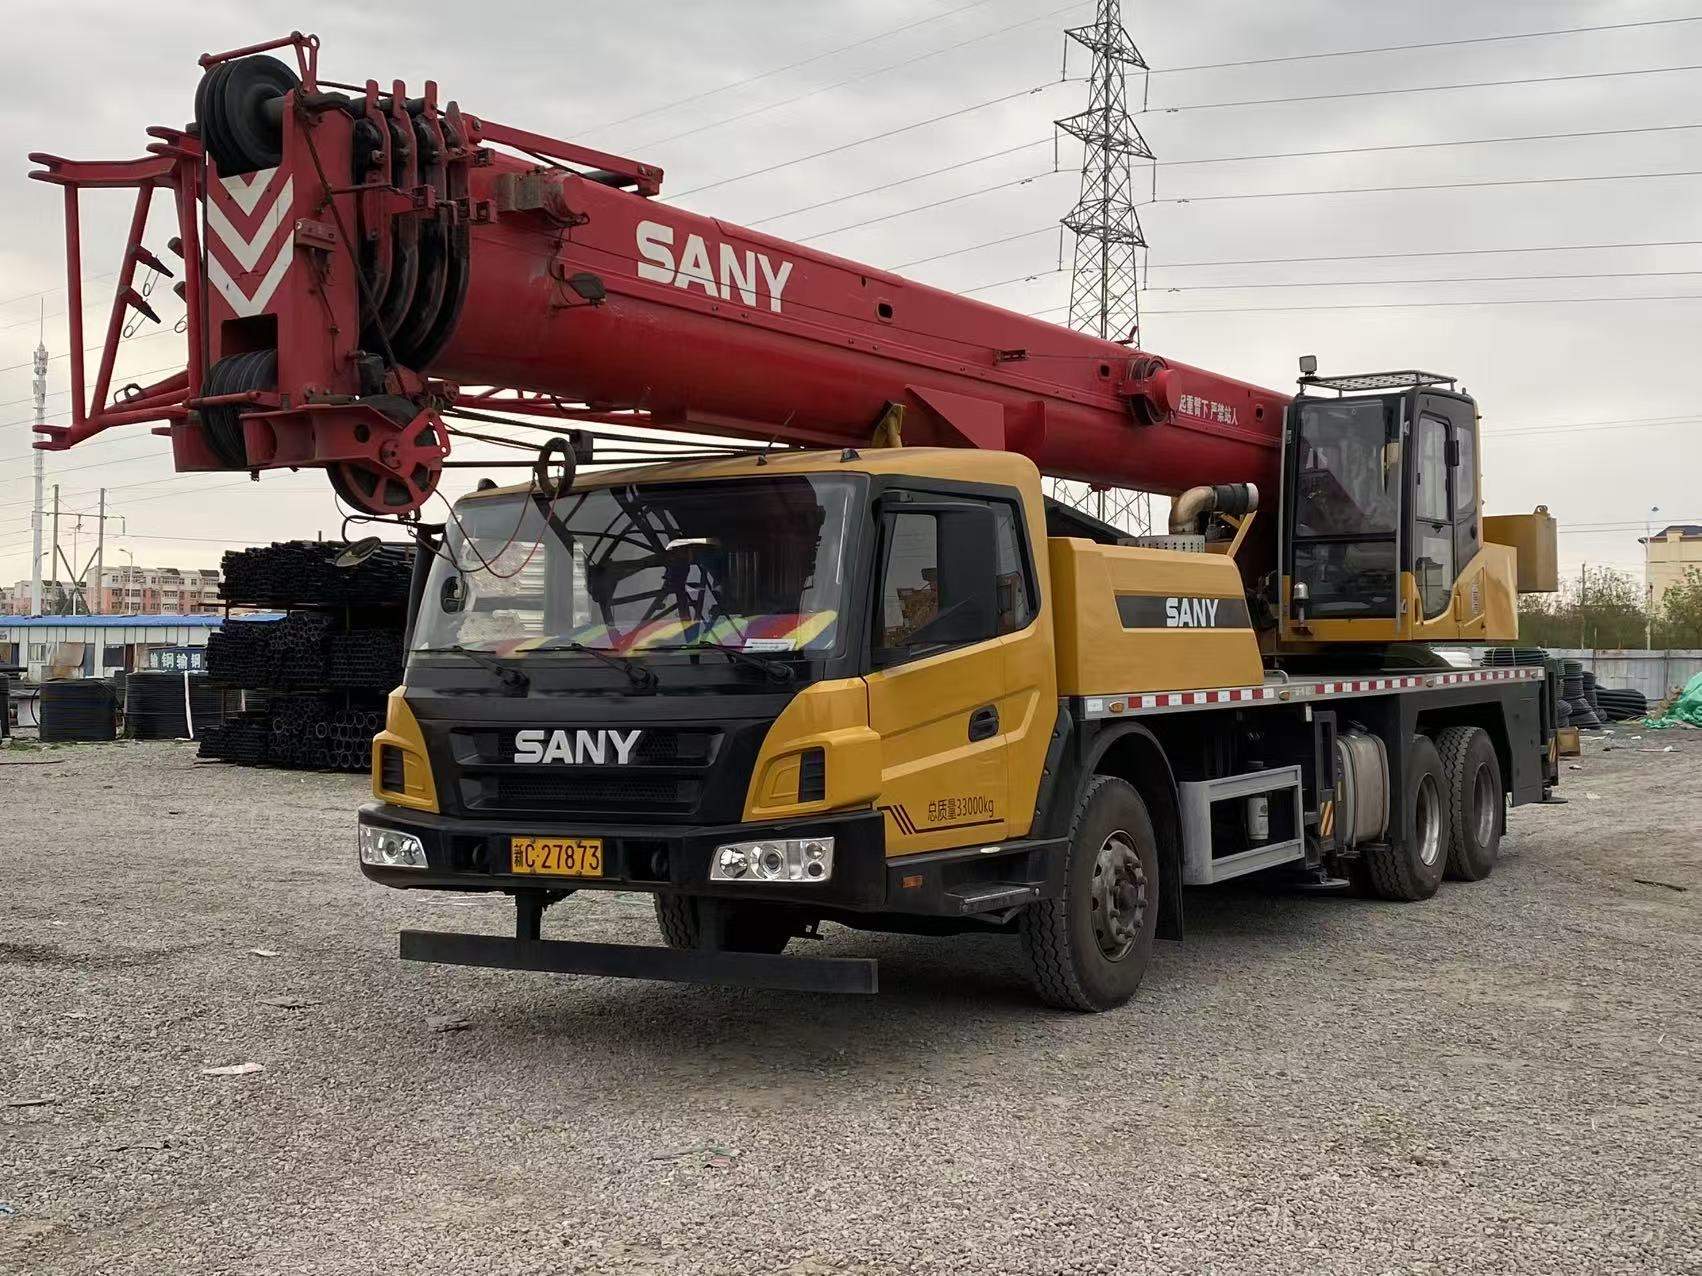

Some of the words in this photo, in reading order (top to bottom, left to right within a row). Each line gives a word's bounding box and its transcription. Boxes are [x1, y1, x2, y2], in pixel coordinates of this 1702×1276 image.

[636, 219, 794, 313] SANY
[1165, 597, 1219, 627] SANY
[513, 729, 642, 765] SANY
[927, 796, 995, 822] 总质量33000kg
